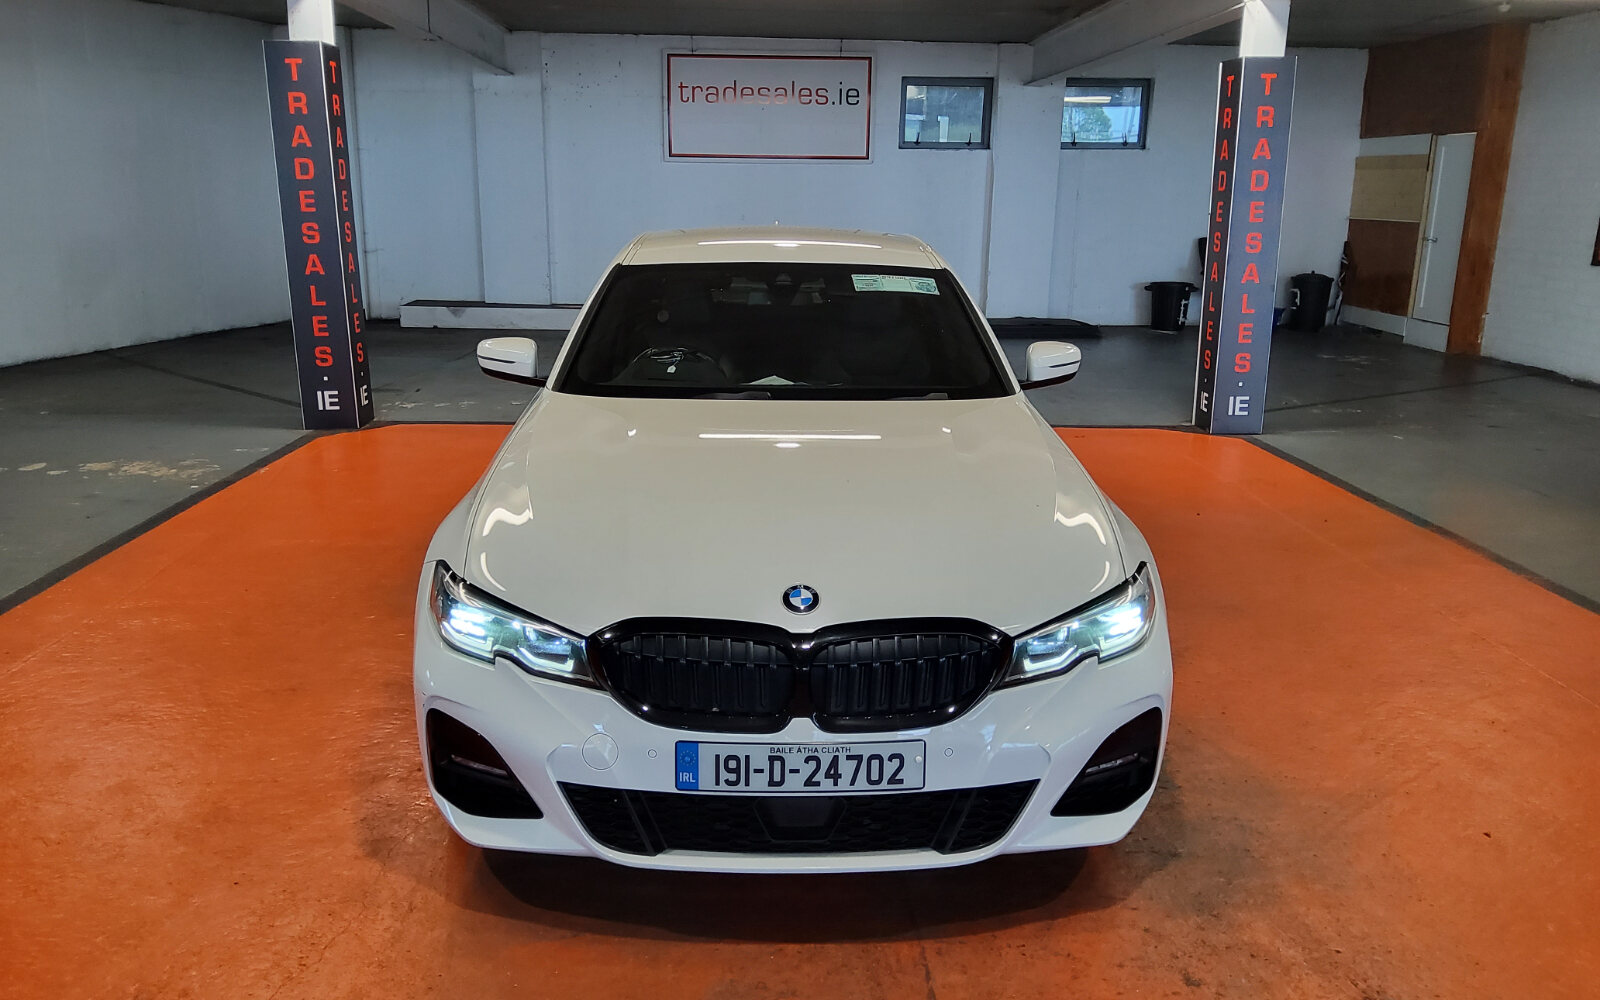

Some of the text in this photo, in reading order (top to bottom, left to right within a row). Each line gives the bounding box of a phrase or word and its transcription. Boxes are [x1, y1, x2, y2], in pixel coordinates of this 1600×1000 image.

[678, 80, 860, 106] tradesales.ie
[769, 746, 794, 754] BAILE
[821, 746, 851, 754] CLIATH
[679, 771, 696, 783] IRL
[714, 753, 905, 788] 191-D-24702
